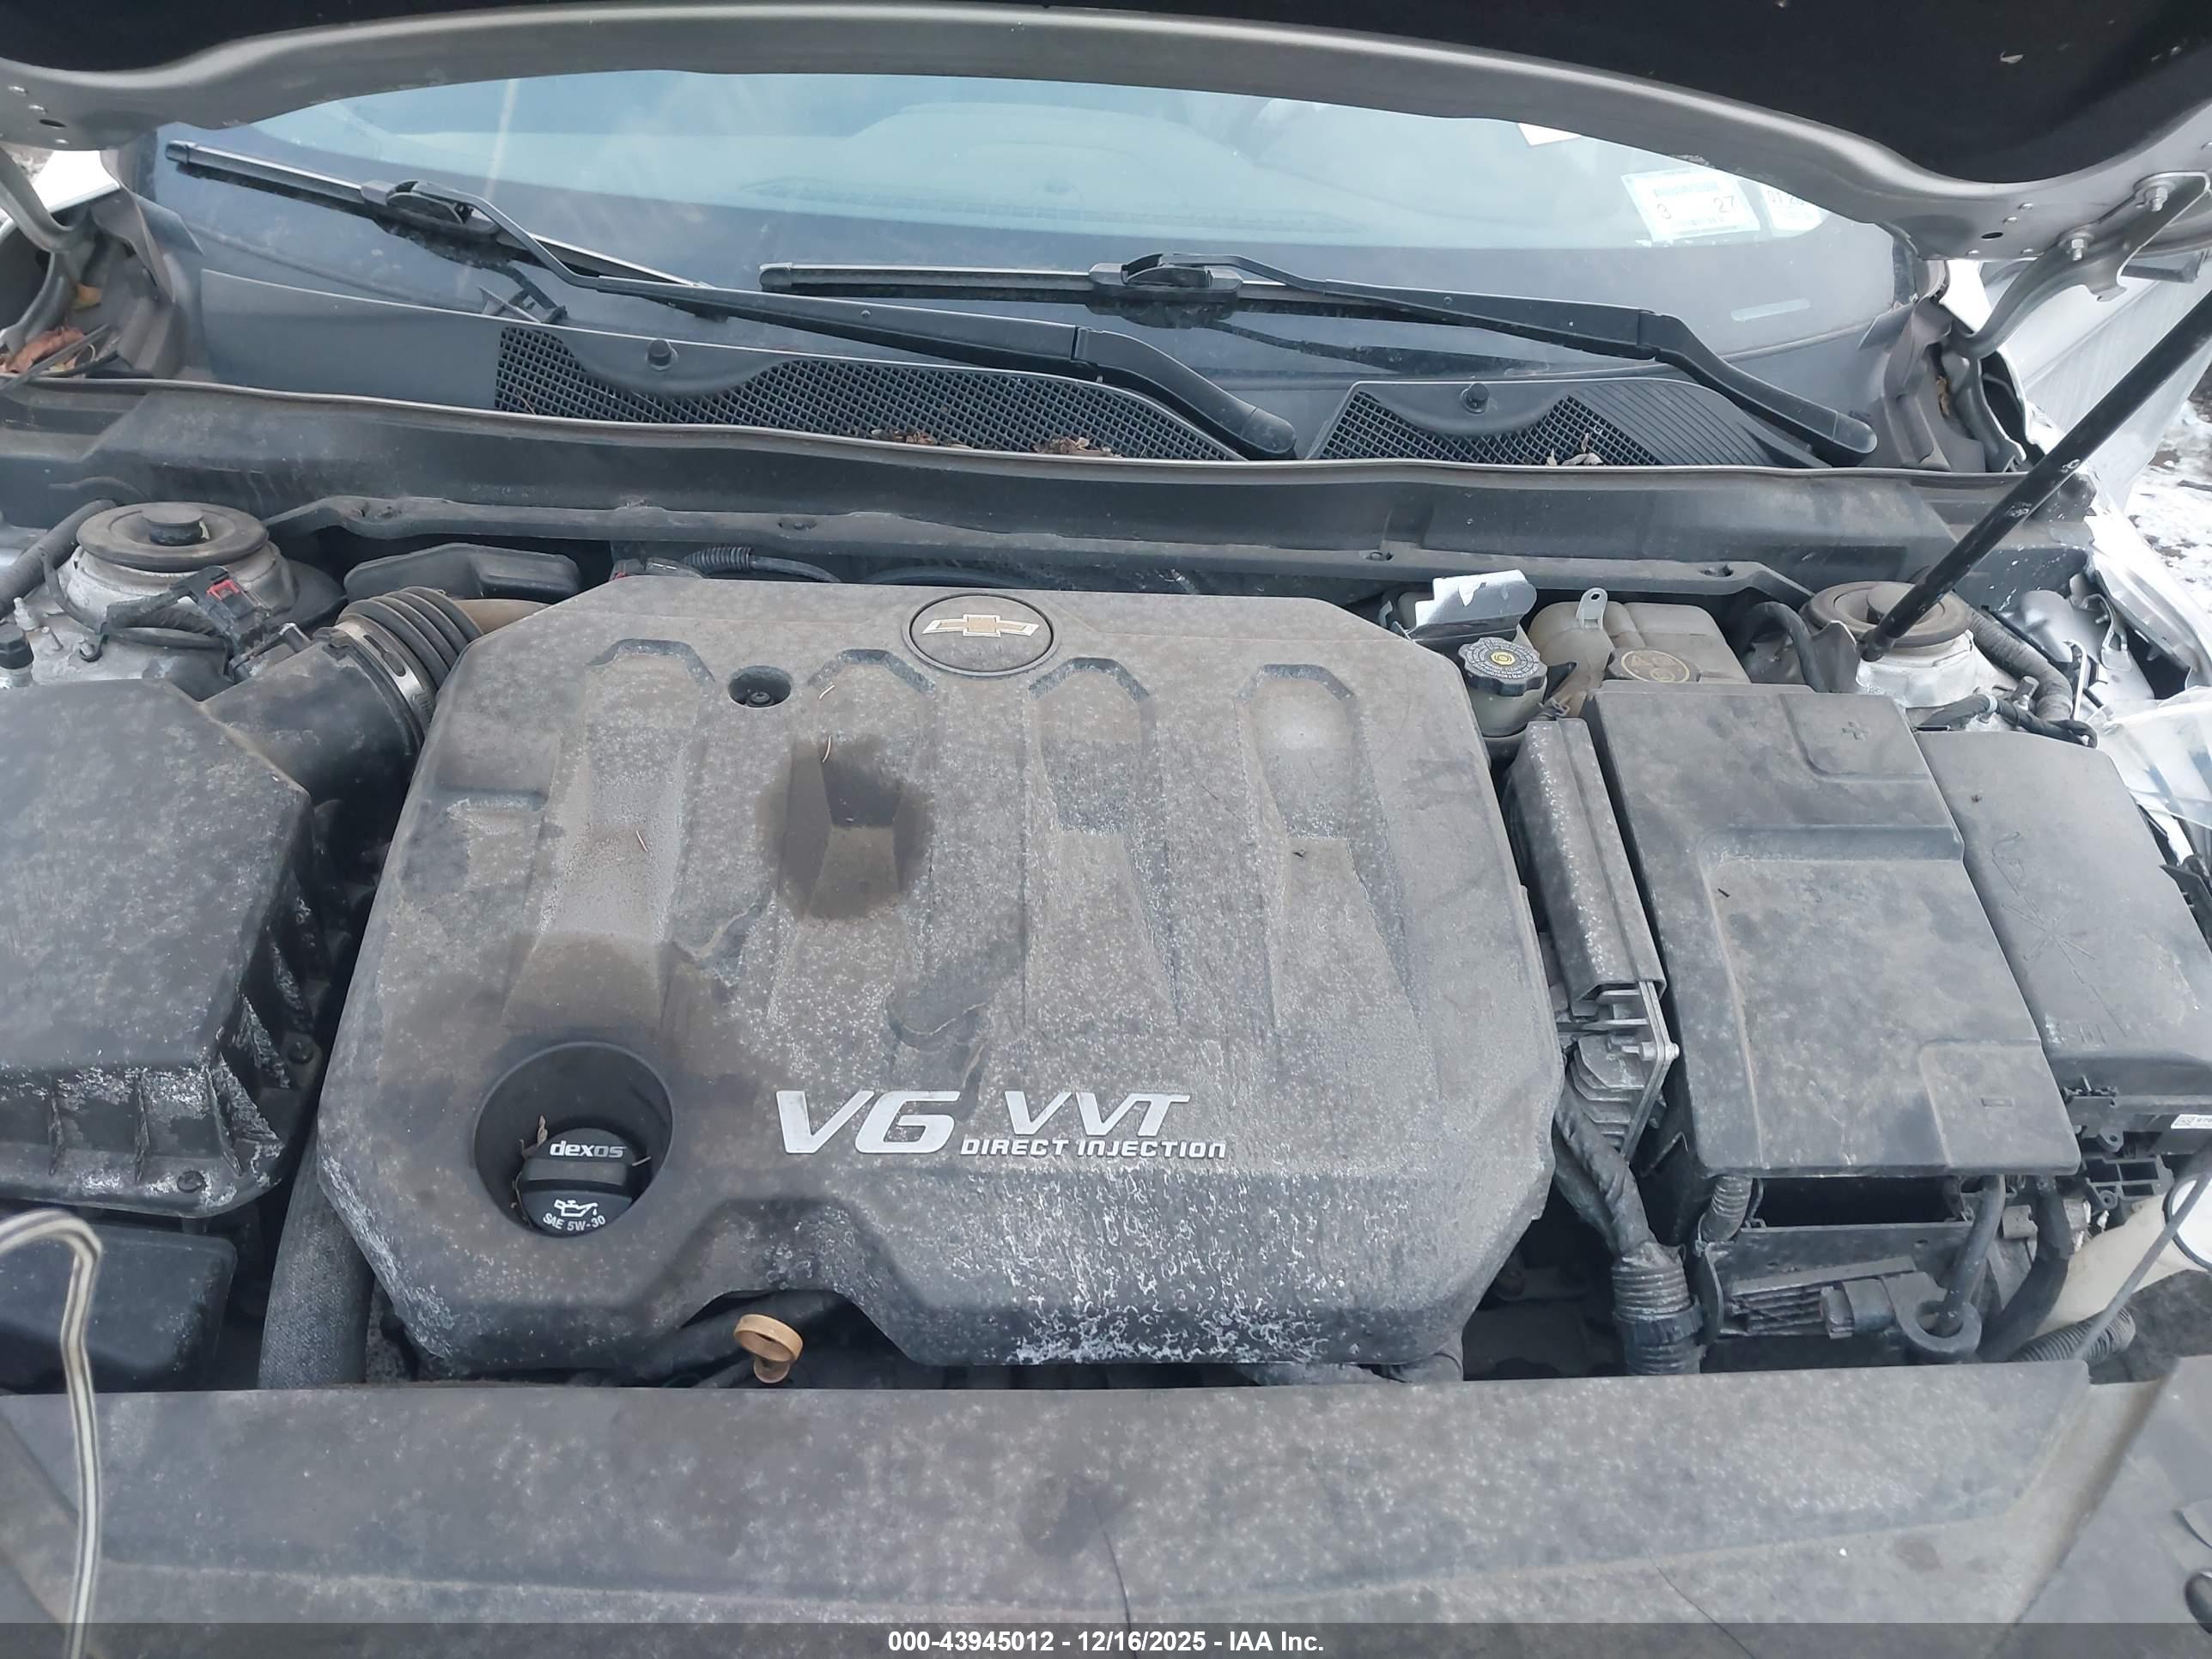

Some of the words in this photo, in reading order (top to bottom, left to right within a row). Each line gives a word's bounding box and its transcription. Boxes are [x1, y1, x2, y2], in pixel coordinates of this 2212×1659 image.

[1656, 203, 1672, 220] 3
[1713, 195, 1735, 213] 27
[775, 1090, 961, 1154] V6
[1004, 1091, 1191, 1137] VVT
[549, 1139, 627, 1158] dexos
[959, 1138, 1070, 1156] DIRECT
[542, 1212, 564, 1229] SAE
[567, 1215, 606, 1231] 5W-30
